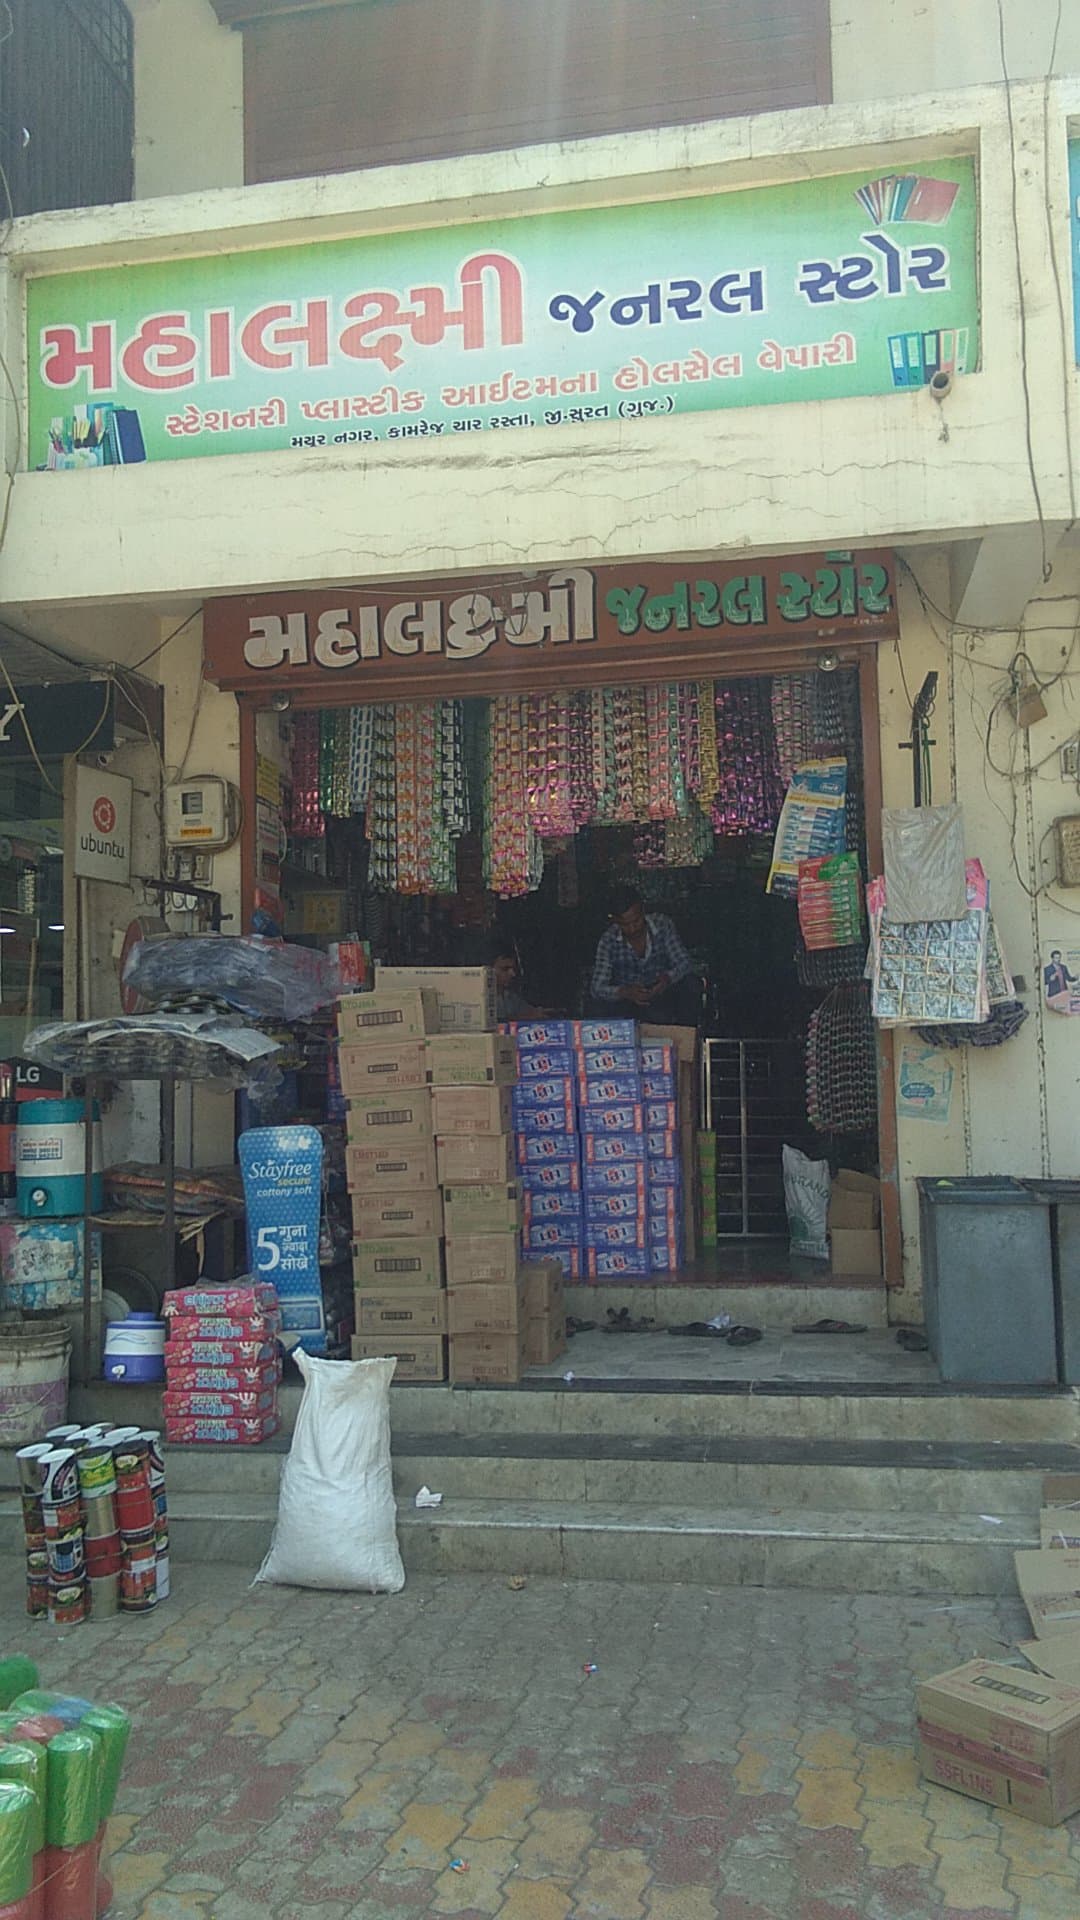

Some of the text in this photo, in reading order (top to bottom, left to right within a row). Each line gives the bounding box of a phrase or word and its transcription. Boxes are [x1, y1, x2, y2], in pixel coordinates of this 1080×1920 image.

[44, 233, 947, 390] મહાલક્ષ્મી જનરલ સ્ટોર
[167, 333, 855, 435] સ્ટેશનરી પ્લાસ્ટીક આઈટમના હોલસેલ વેપારી
[387, 419, 445, 437] કામરેજ
[452, 416, 482, 432] ચાર
[605, 575, 767, 635] જનરલ
[776, 550, 892, 622] સ્ટોર
[80, 832, 125, 859] ubuntu
[16, 1066, 40, 1082] LG
[249, 1159, 312, 1181] Stayfree
[256, 1185, 312, 1198] cottony soft
[276, 1177, 311, 1187] secure
[256, 1224, 307, 1271] 5 गुना
[280, 1255, 309, 1271] सोखे
